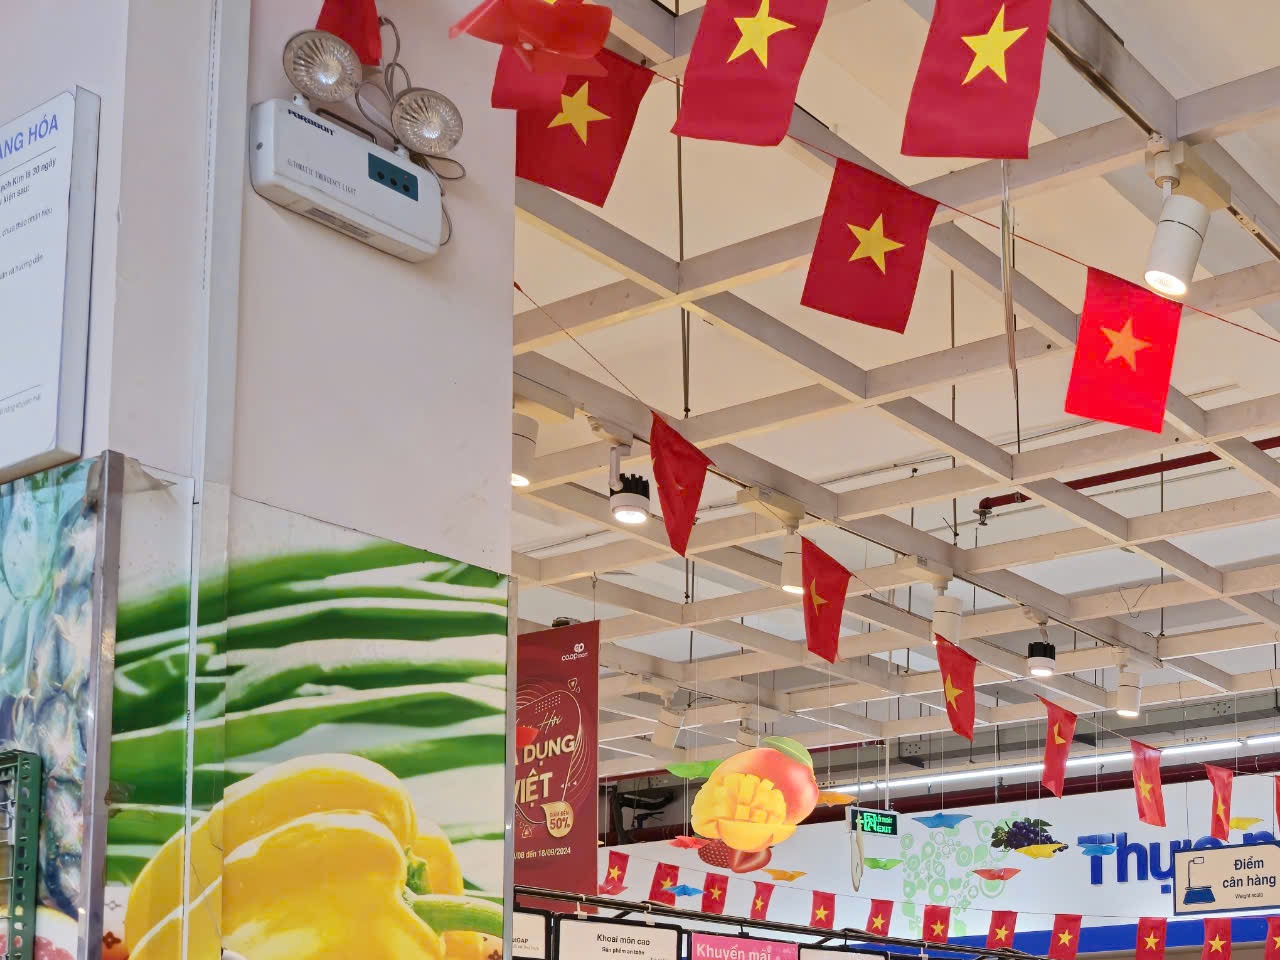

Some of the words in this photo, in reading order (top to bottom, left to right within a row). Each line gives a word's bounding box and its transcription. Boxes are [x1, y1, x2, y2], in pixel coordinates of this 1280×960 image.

[0, 132, 24, 160] NG
[28, 114, 59, 145] HÓA
[523, 734, 575, 766] DỤNG
[549, 816, 570, 830] 50%
[877, 825, 893, 833] EXIT
[1077, 831, 1225, 894] Thự
[1234, 855, 1264, 871] Điểm
[1247, 873, 1277, 888] hàng
[597, 933, 619, 944] Khoai
